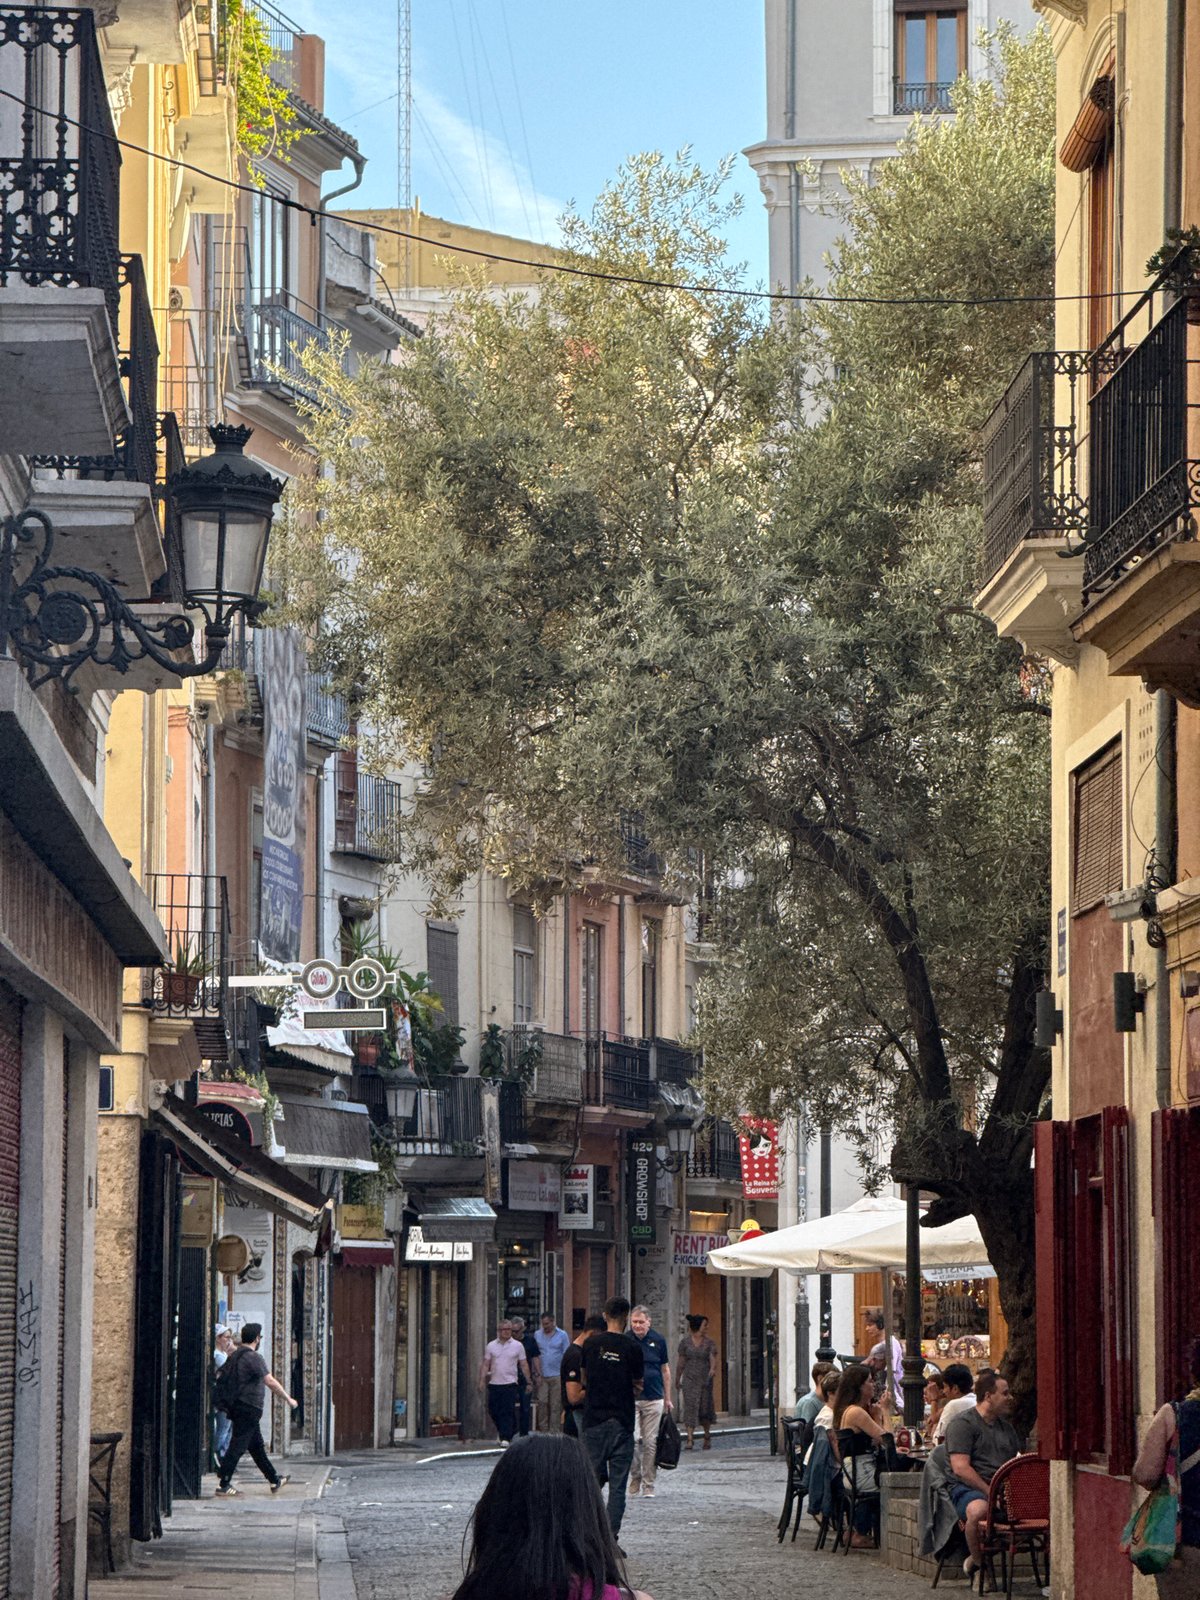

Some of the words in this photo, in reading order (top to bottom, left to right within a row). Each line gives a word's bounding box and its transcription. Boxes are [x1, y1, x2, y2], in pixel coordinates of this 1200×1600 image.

[632, 1142, 653, 1152] 420
[636, 1158, 648, 1221] GROWSHOP
[745, 1186, 778, 1194] Souveni
[631, 1225, 652, 1234] CBD
[674, 1234, 706, 1254] RENT
[708, 1236, 729, 1251] BIK
[673, 1254, 698, 1265] E-KICK
